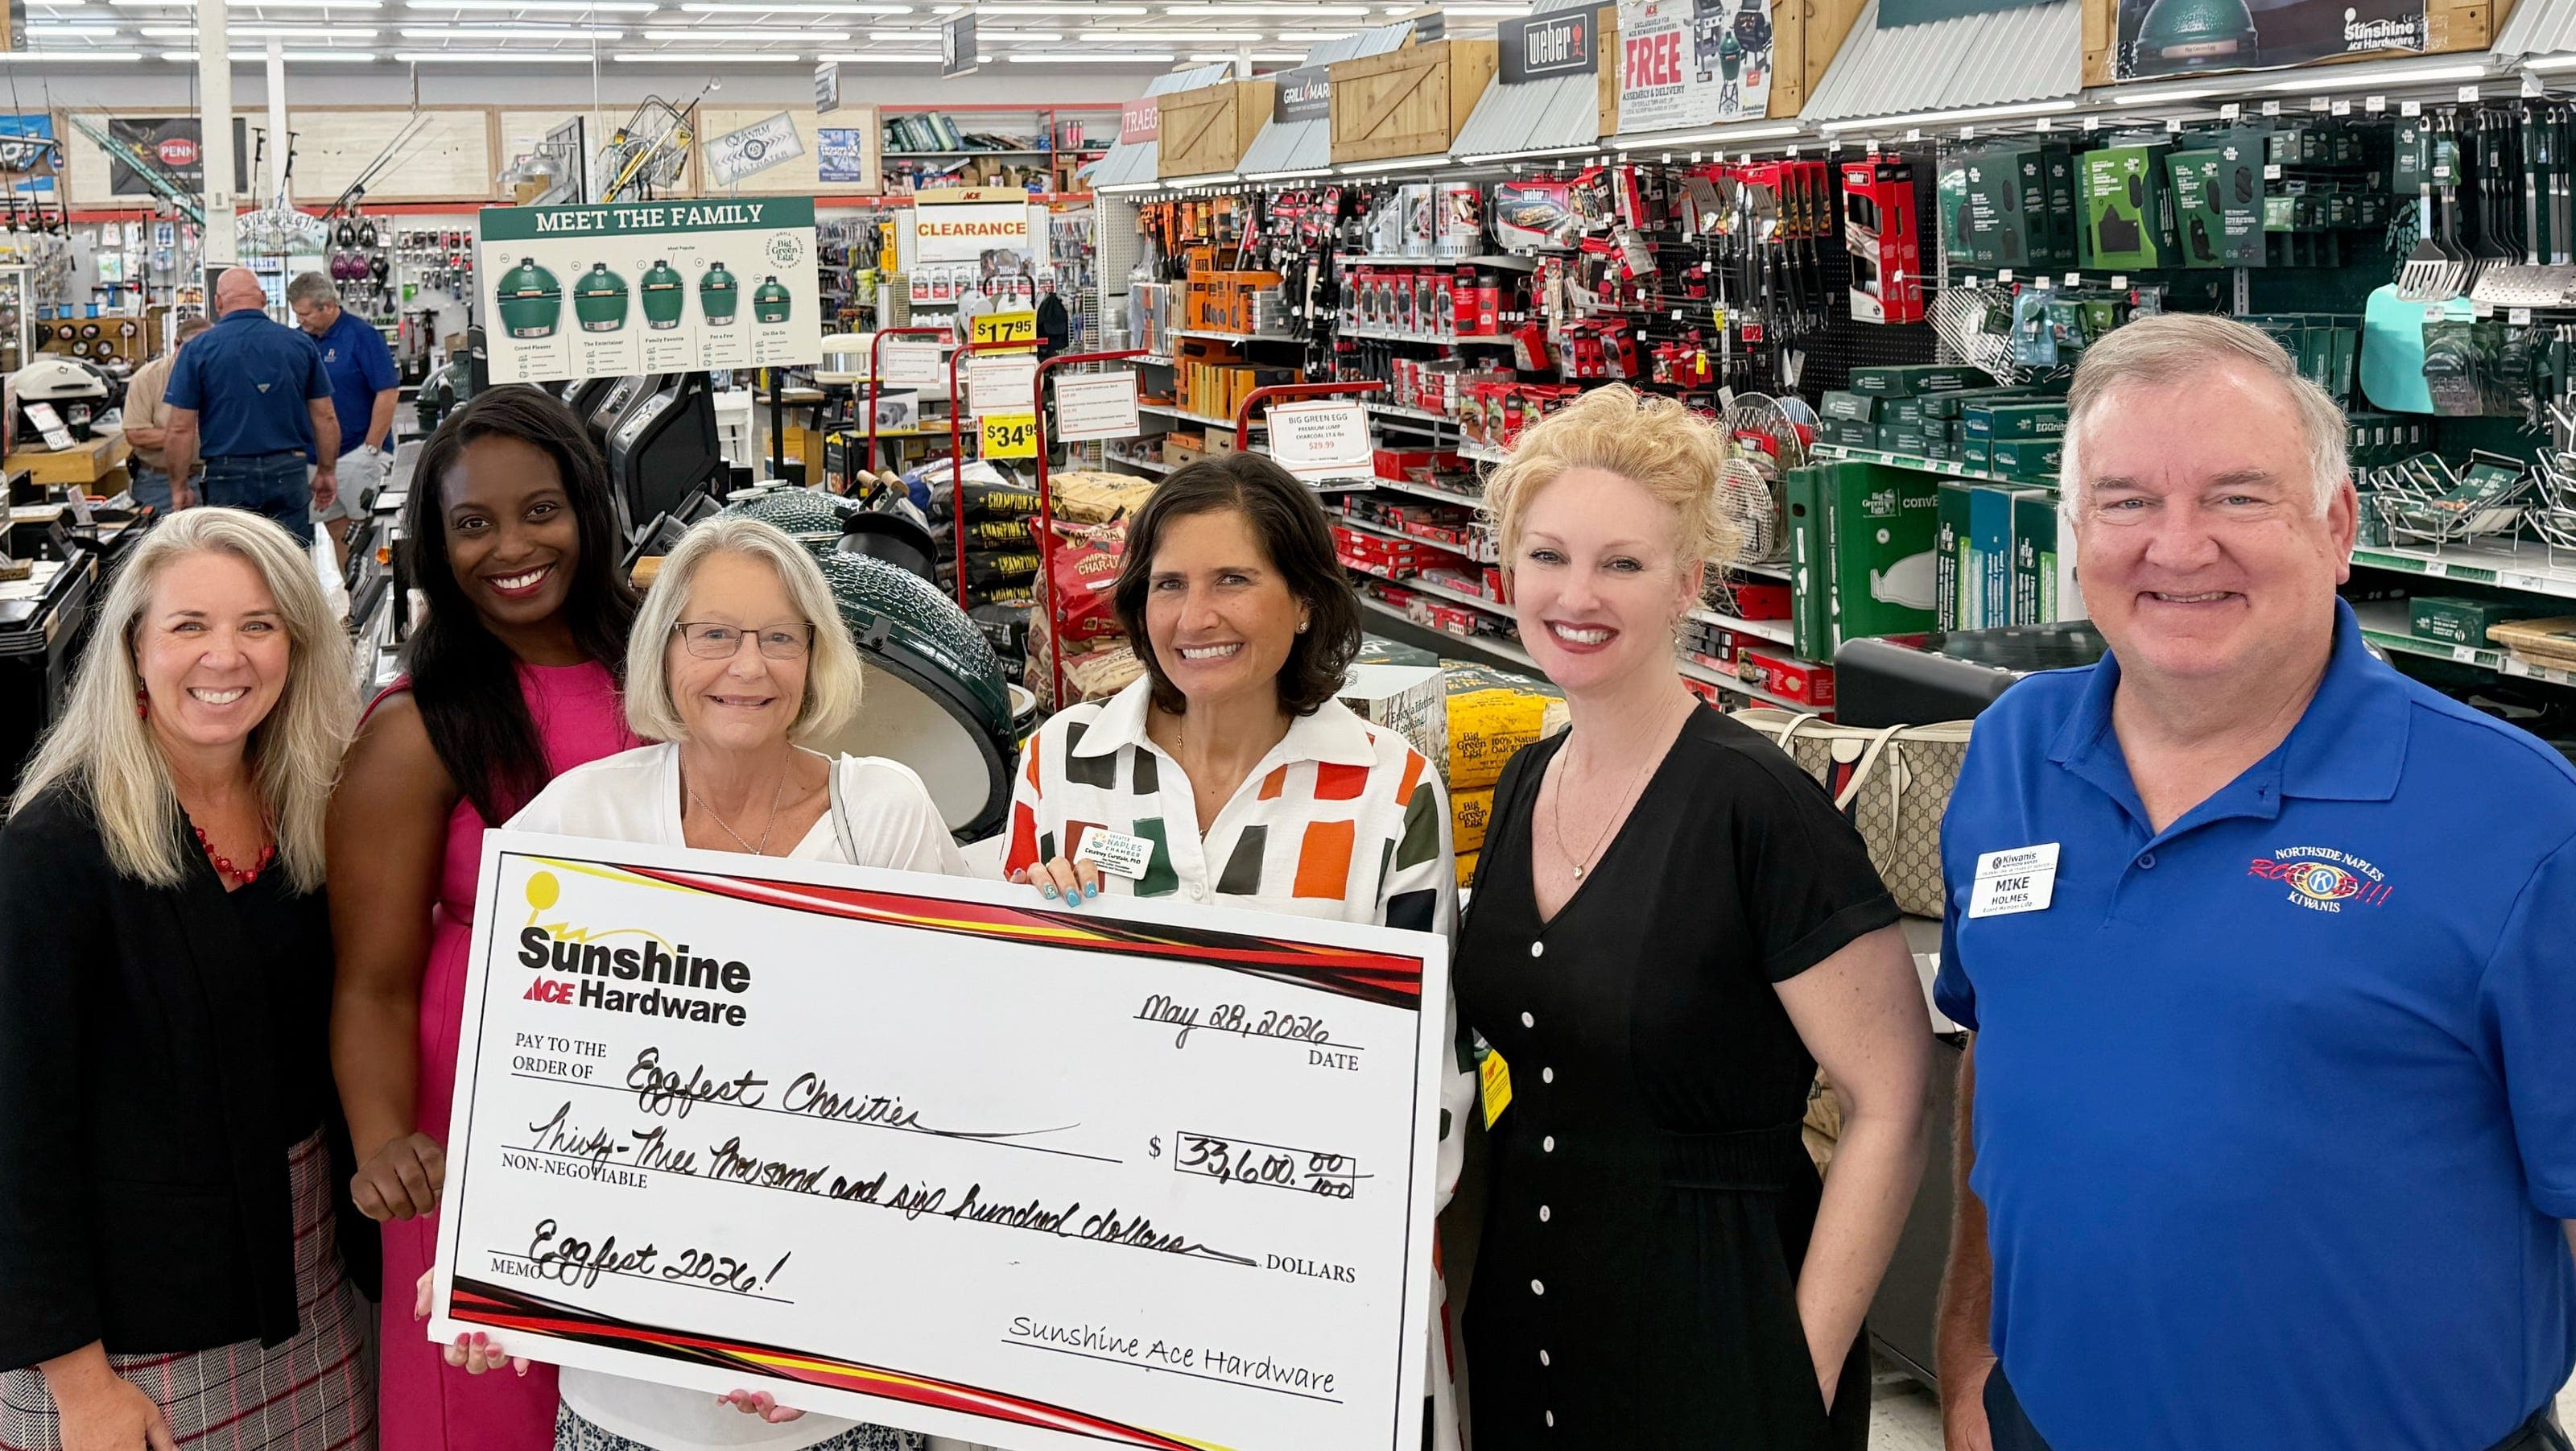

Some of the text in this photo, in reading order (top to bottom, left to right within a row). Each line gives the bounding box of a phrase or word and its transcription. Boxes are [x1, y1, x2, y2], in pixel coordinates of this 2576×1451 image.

[2344, 21, 2414, 39] Sunshine
[1530, 22, 1571, 64] weber
[2347, 36, 2414, 51] ACE Hardware
[1625, 31, 1682, 89] FREE
[1284, 87, 1304, 104] GRILL
[1623, 90, 1649, 101] ASSEMBLY
[1655, 85, 1685, 96] DELIVERY
[1125, 106, 1158, 134] TRAEG
[725, 125, 770, 148] QUANTUM
[161, 145, 195, 158] PENN
[963, 192, 981, 200] ACE
[535, 204, 764, 232] MEET THE FAMILY
[918, 221, 1026, 237] CLEARANCE
[772, 246, 798, 255] Green
[778, 240, 792, 248] Big
[777, 253, 794, 263] Egg
[1288, 413, 1348, 424] BIG GREEN EGG
[1309, 441, 1335, 450] $29.99
[1391, 709, 1409, 724] Enjoy
[1456, 739, 1486, 751] Green
[1463, 732, 1480, 742] Big
[1492, 736, 1513, 746] 100%
[1463, 749, 1482, 759] Egg
[1492, 745, 1509, 754] Oak
[1463, 800, 1479, 811] Big
[1458, 808, 1487, 821] Green
[1464, 817, 1483, 828] Egg
[1105, 846, 1141, 858] CHAMBER
[1107, 839, 1143, 852] NAPLES
[2003, 851, 2037, 864] Kiwanis
[2275, 846, 2385, 882] NORTHSIDE NAPLES
[1996, 876, 2030, 893] MIKE
[1992, 893, 2029, 905] HOLMES
[2287, 891, 2341, 913] KIWANIS
[518, 926, 750, 993] Sunshine
[523, 975, 747, 1027] ACE Hardware
[1138, 994, 1199, 1048] May
[515, 1032, 607, 1058] PAY TO THE
[513, 1056, 593, 1079] ORDER OF
[1309, 1050, 1359, 1072] DATE
[627, 1047, 966, 1135] Eggfest Charities
[1149, 1135, 1162, 1160] $
[502, 1153, 648, 1190] NON-NEGOTIABLE
[829, 1172, 888, 1201] and
[886, 1180, 947, 1222] six
[945, 1183, 1080, 1238] hundred
[1081, 1209, 1232, 1260] dollars
[529, 1218, 792, 1292] Eggfest 2026!
[491, 1258, 542, 1279] MEMO
[1266, 1254, 1356, 1284] DOLLARS
[1009, 1317, 1335, 1393] Sunshine Ace Hardware
